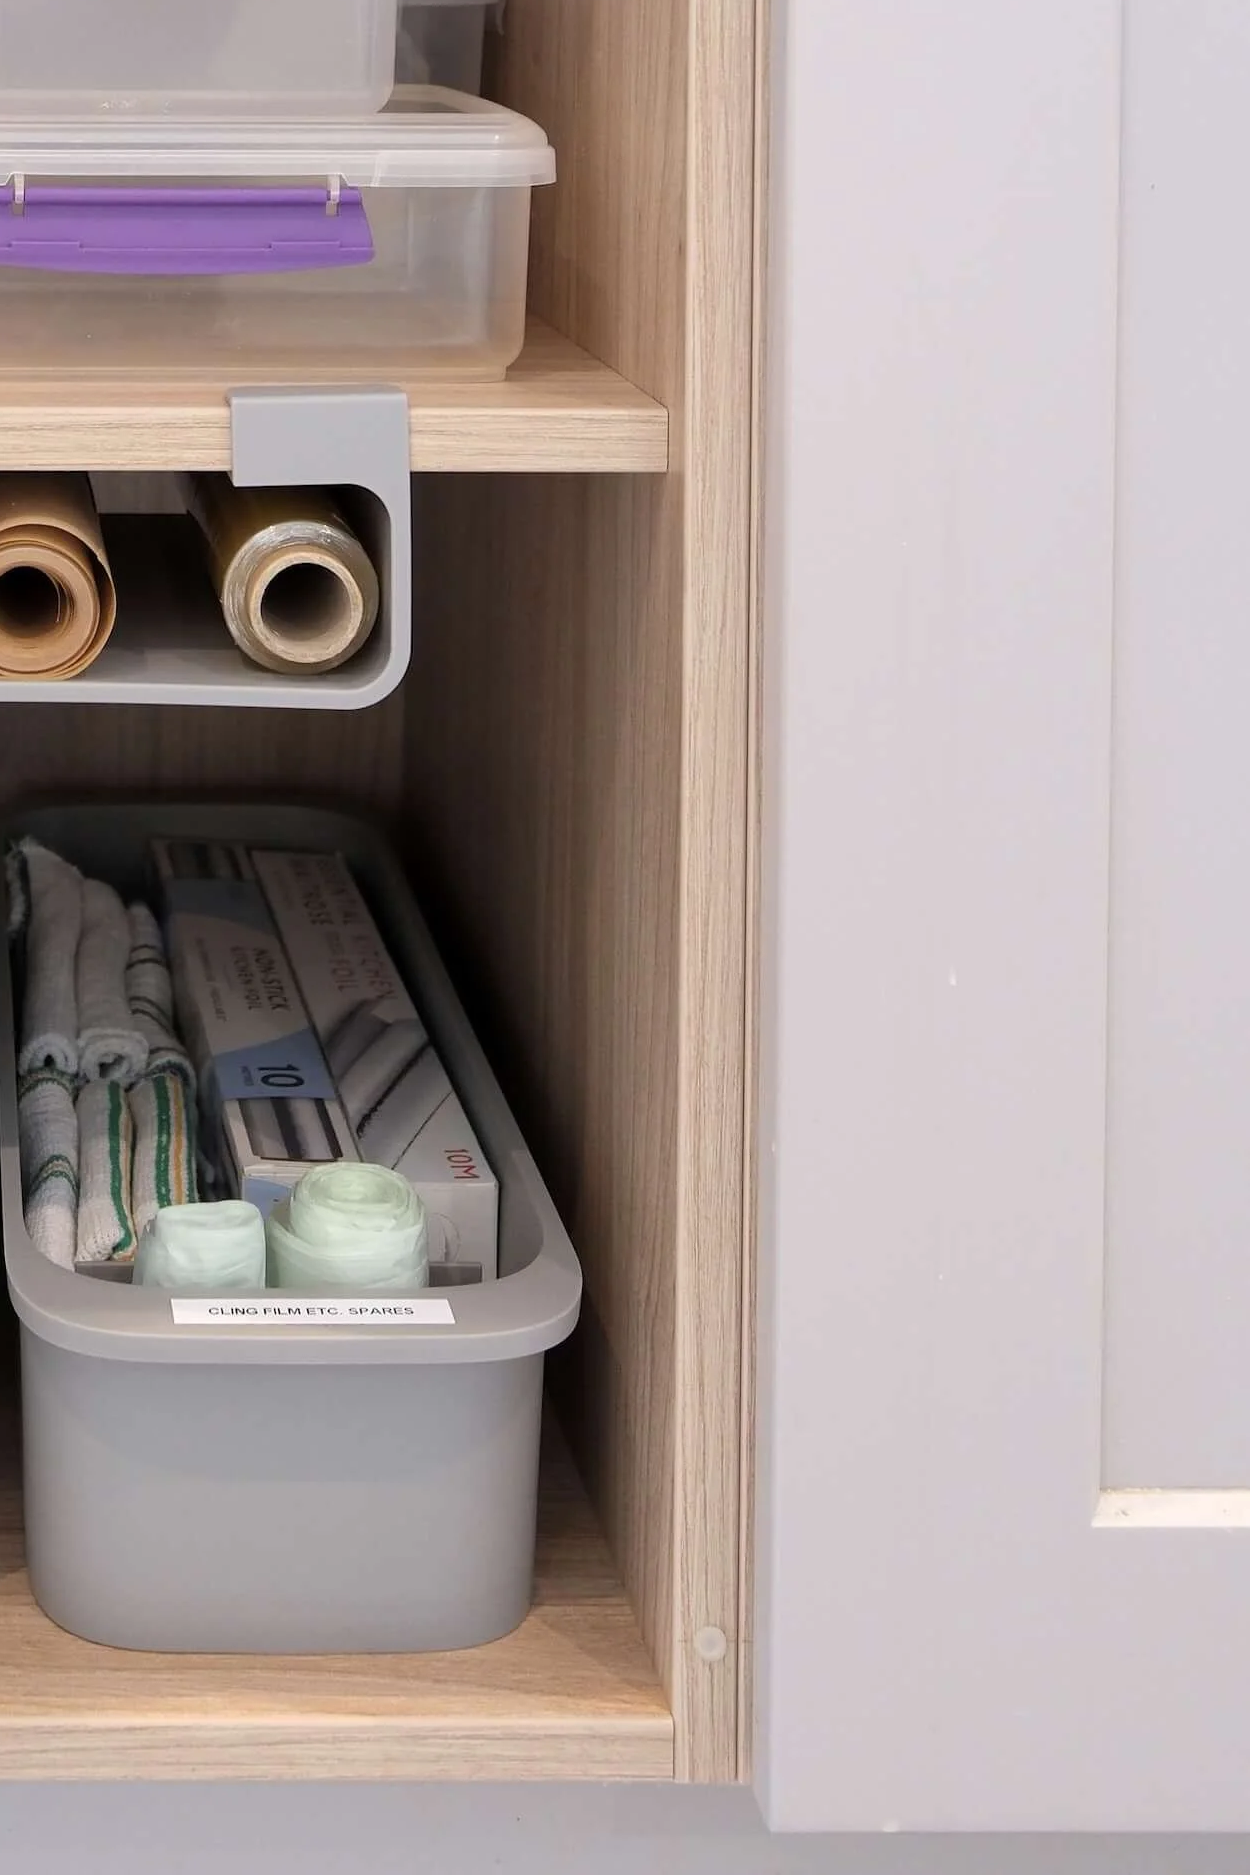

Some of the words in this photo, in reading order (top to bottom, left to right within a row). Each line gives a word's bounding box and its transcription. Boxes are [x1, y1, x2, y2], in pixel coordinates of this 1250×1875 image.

[256, 1063, 305, 1088] 10
[444, 1148, 480, 1179] 10M
[207, 1306, 258, 1316] CLING
[262, 1306, 301, 1316] FILM
[306, 1306, 343, 1316] ETC.
[348, 1306, 415, 1316] SPARES
